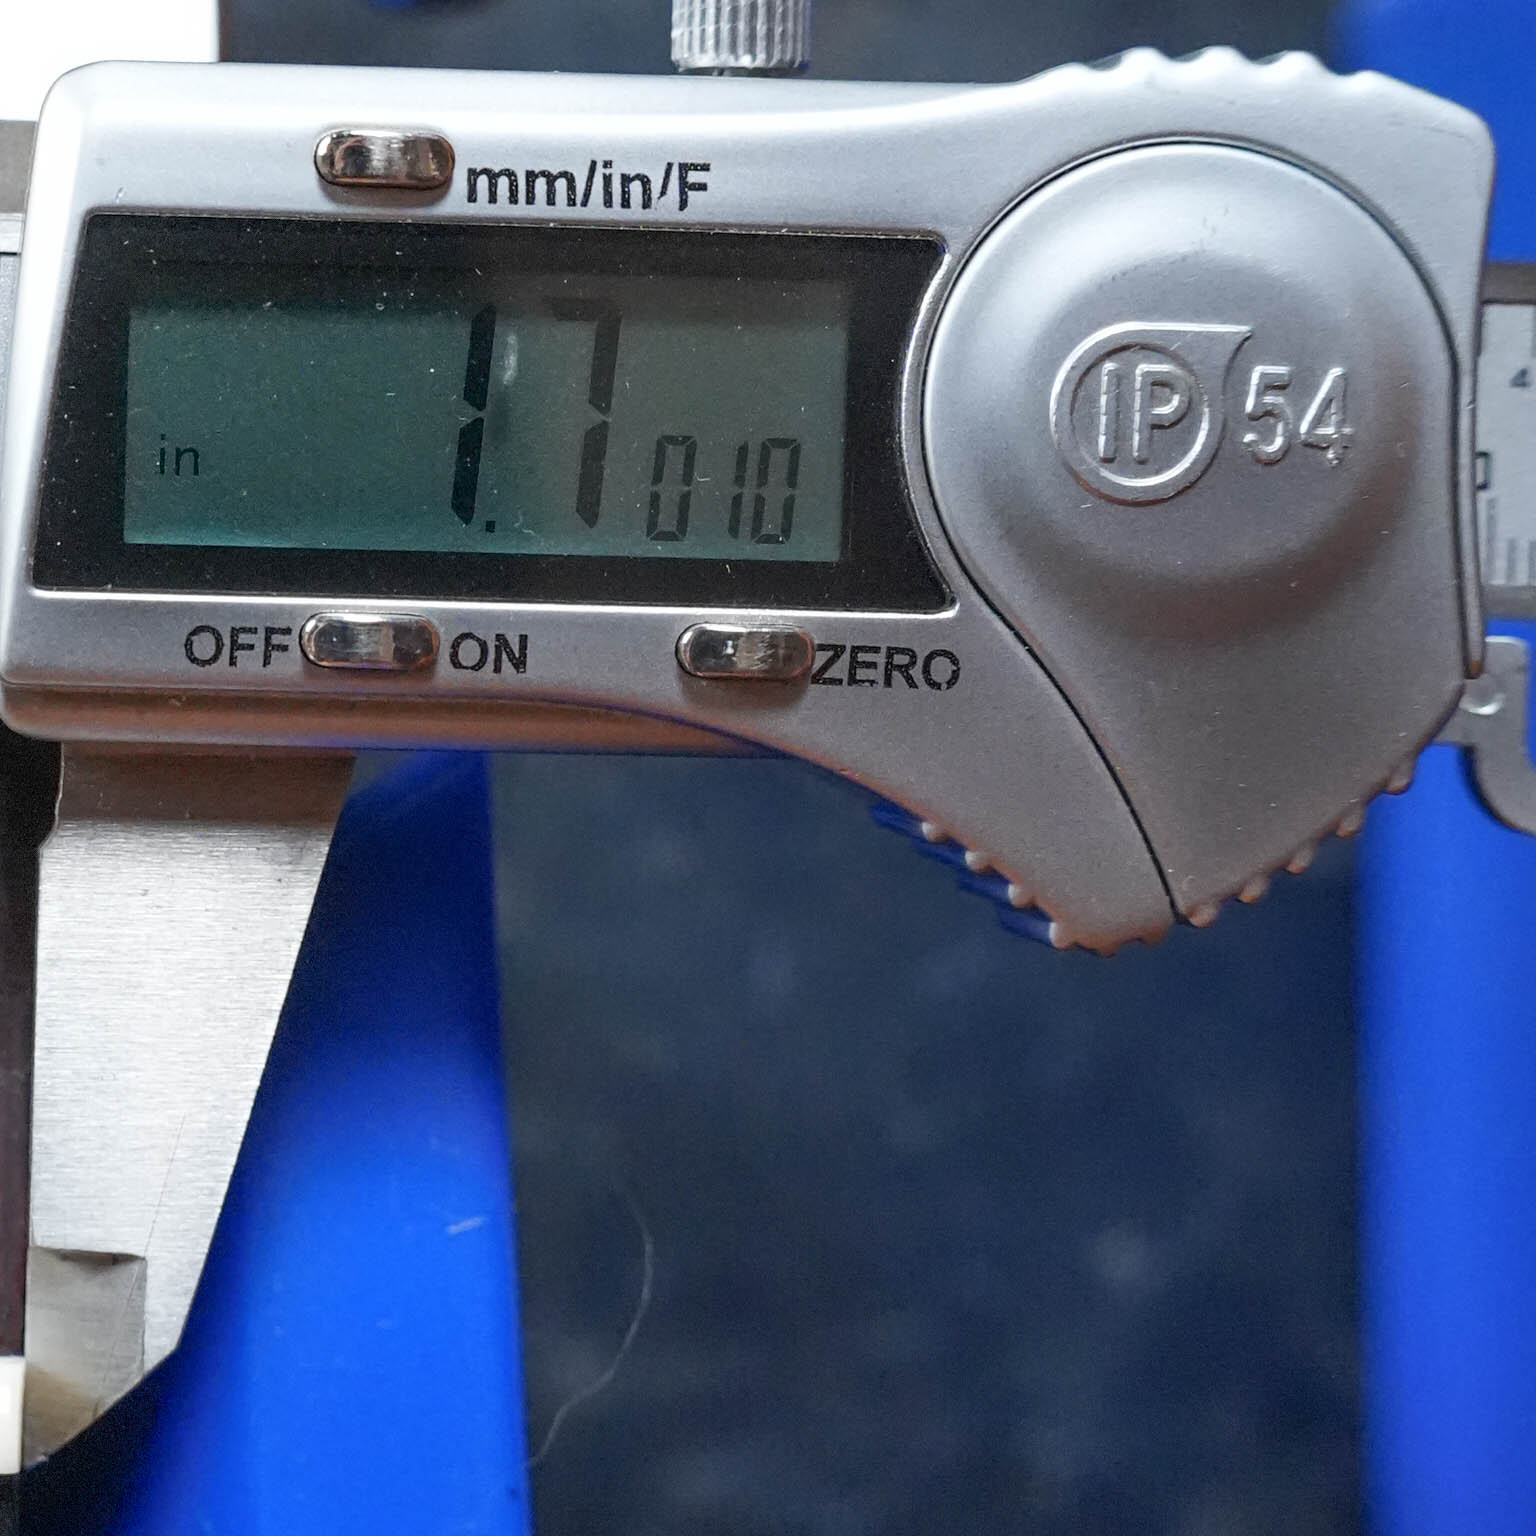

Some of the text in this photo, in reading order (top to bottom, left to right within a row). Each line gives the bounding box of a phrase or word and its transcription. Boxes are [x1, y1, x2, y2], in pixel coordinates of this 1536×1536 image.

[466, 160, 709, 212] mm/in/F
[158, 434, 199, 476] in
[185, 624, 960, 690] OFF ON ZERO
